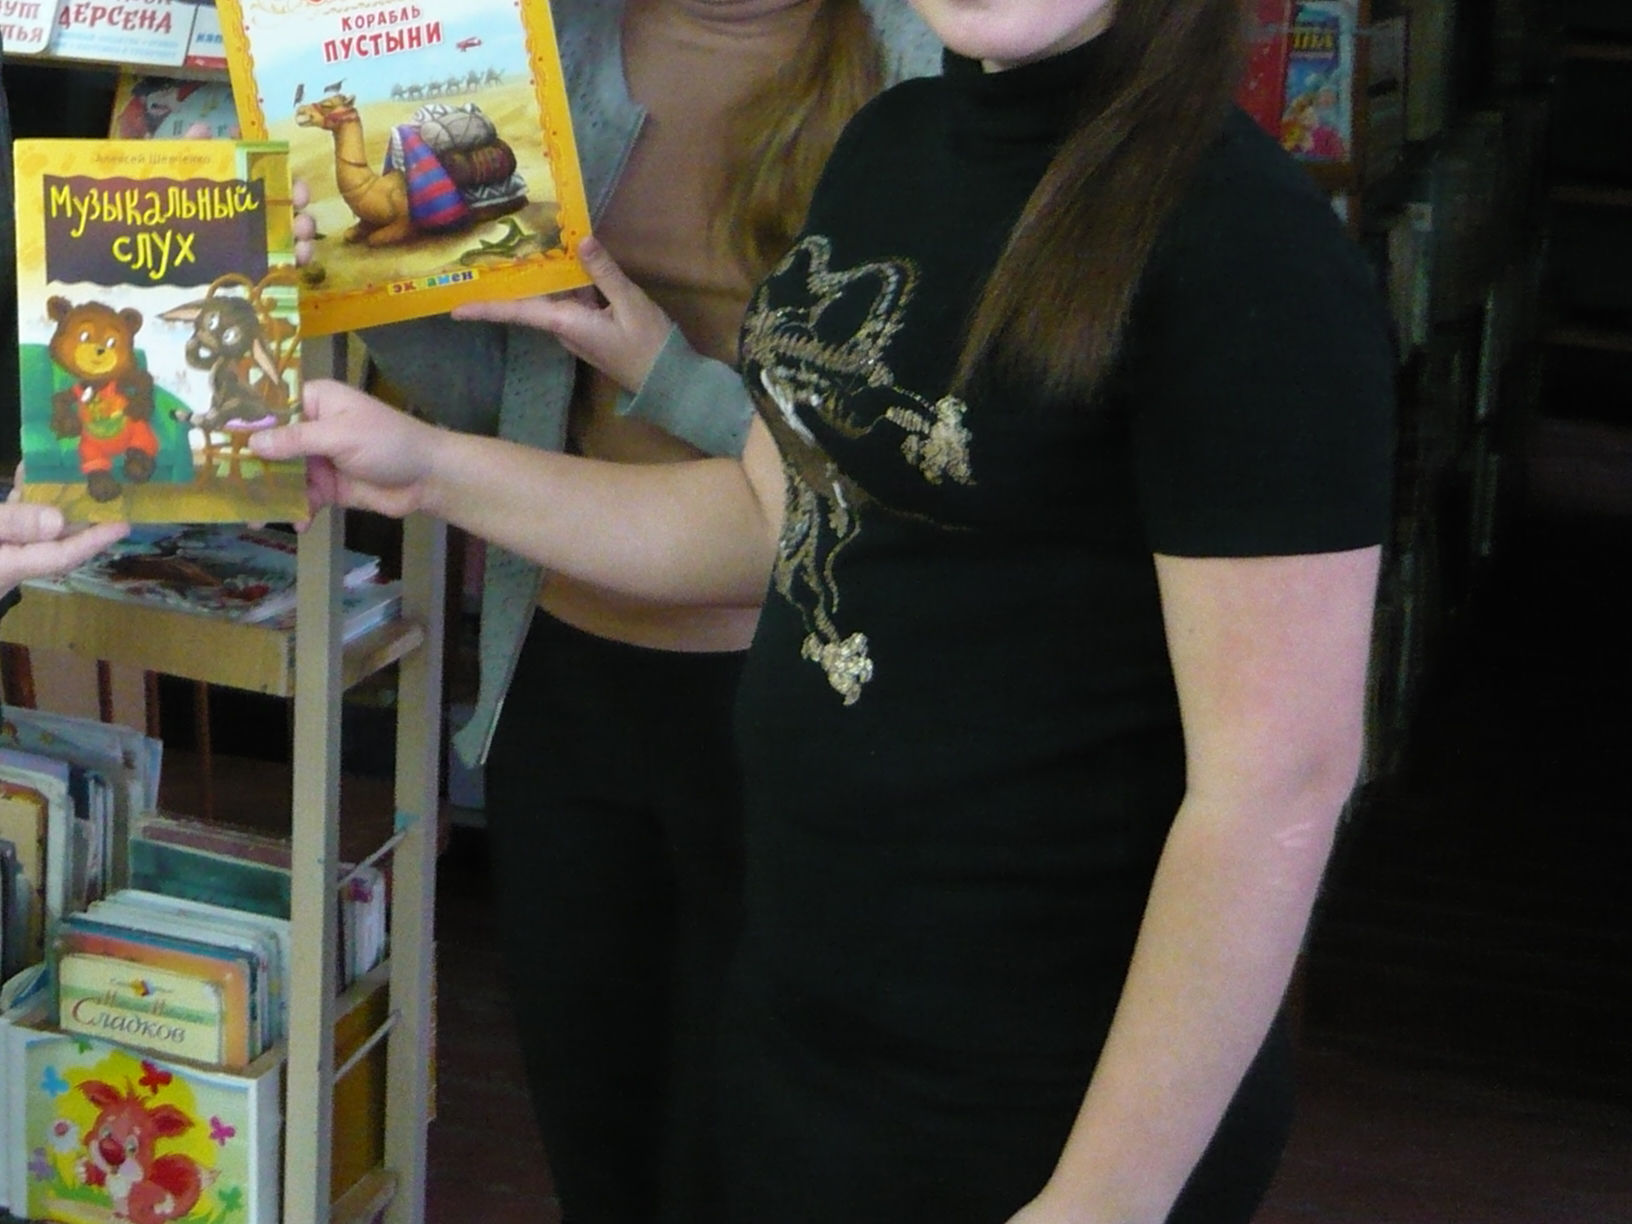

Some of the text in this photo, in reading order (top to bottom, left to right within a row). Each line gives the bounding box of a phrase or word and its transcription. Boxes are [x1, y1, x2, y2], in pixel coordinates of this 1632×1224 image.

[341, 5, 422, 32] КОРАБЛЬ
[323, 21, 442, 63] ПУСТЫНИ
[49, 184, 260, 238] Музыкальный
[71, 996, 186, 1044] Сладков
